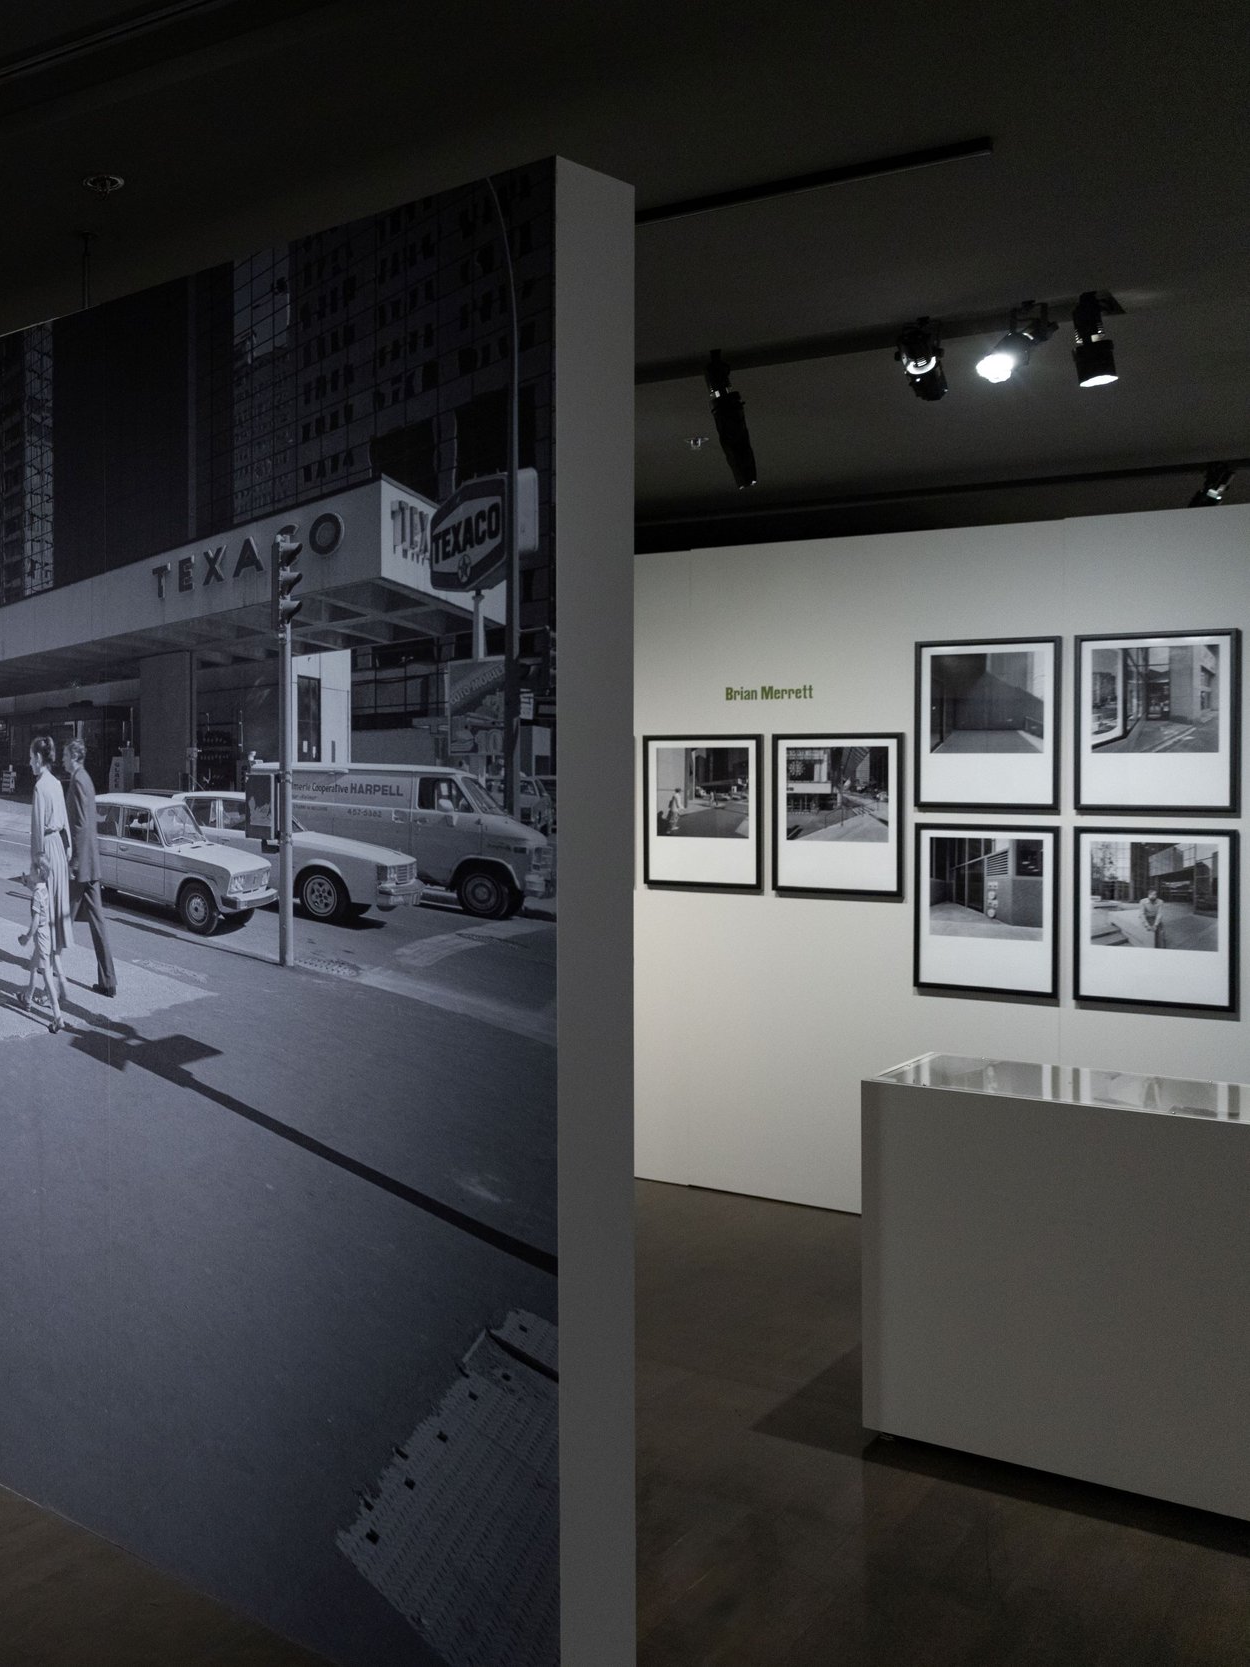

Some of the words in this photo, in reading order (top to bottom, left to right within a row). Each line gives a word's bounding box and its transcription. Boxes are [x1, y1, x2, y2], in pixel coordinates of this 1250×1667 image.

[390, 499, 430, 555] TEX
[431, 502, 501, 565] TEXACO
[725, 686, 758, 701] Brian
[761, 685, 813, 700] Merrett
[350, 783, 403, 796] HARPELL
